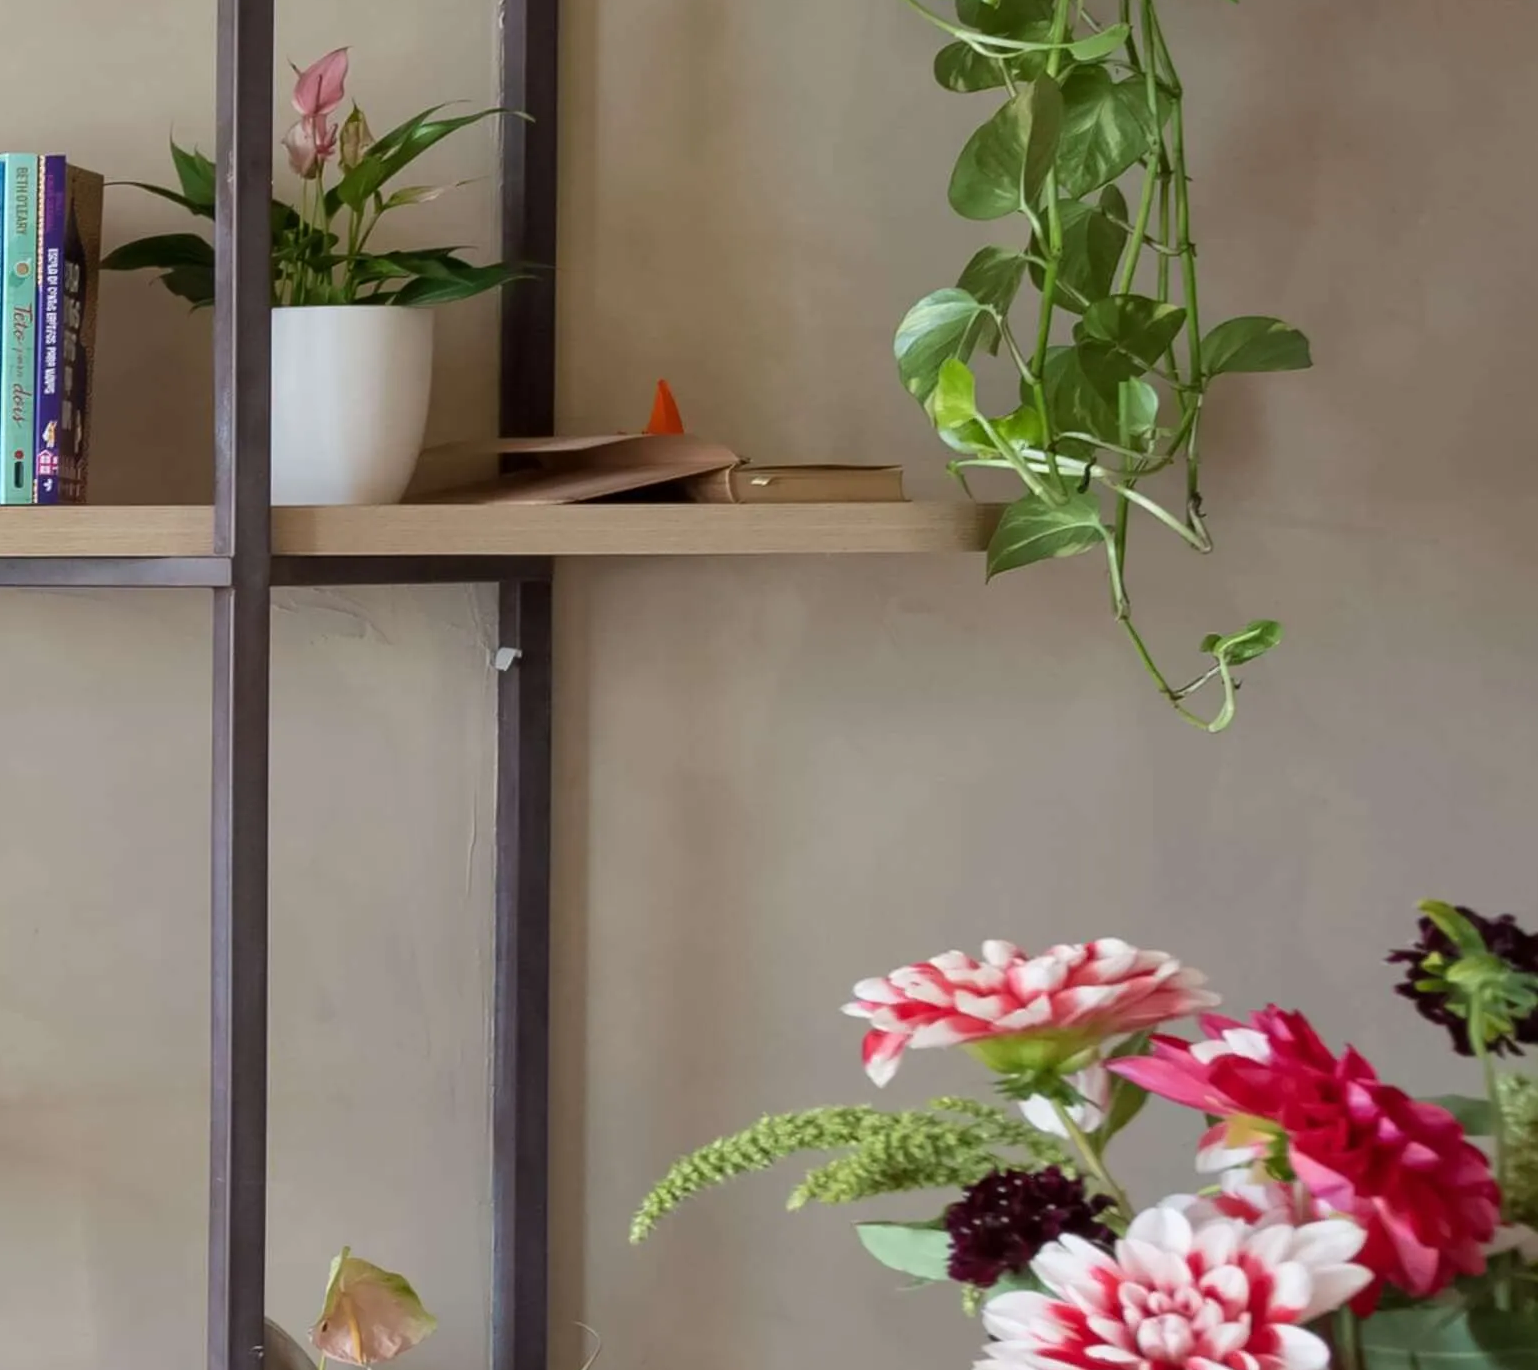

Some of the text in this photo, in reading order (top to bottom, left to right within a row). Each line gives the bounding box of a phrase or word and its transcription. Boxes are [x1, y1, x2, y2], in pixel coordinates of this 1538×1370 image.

[16, 166, 29, 236] BETH O'LEARY
[13, 303, 33, 341] Teto
[12, 383, 32, 428] dois
